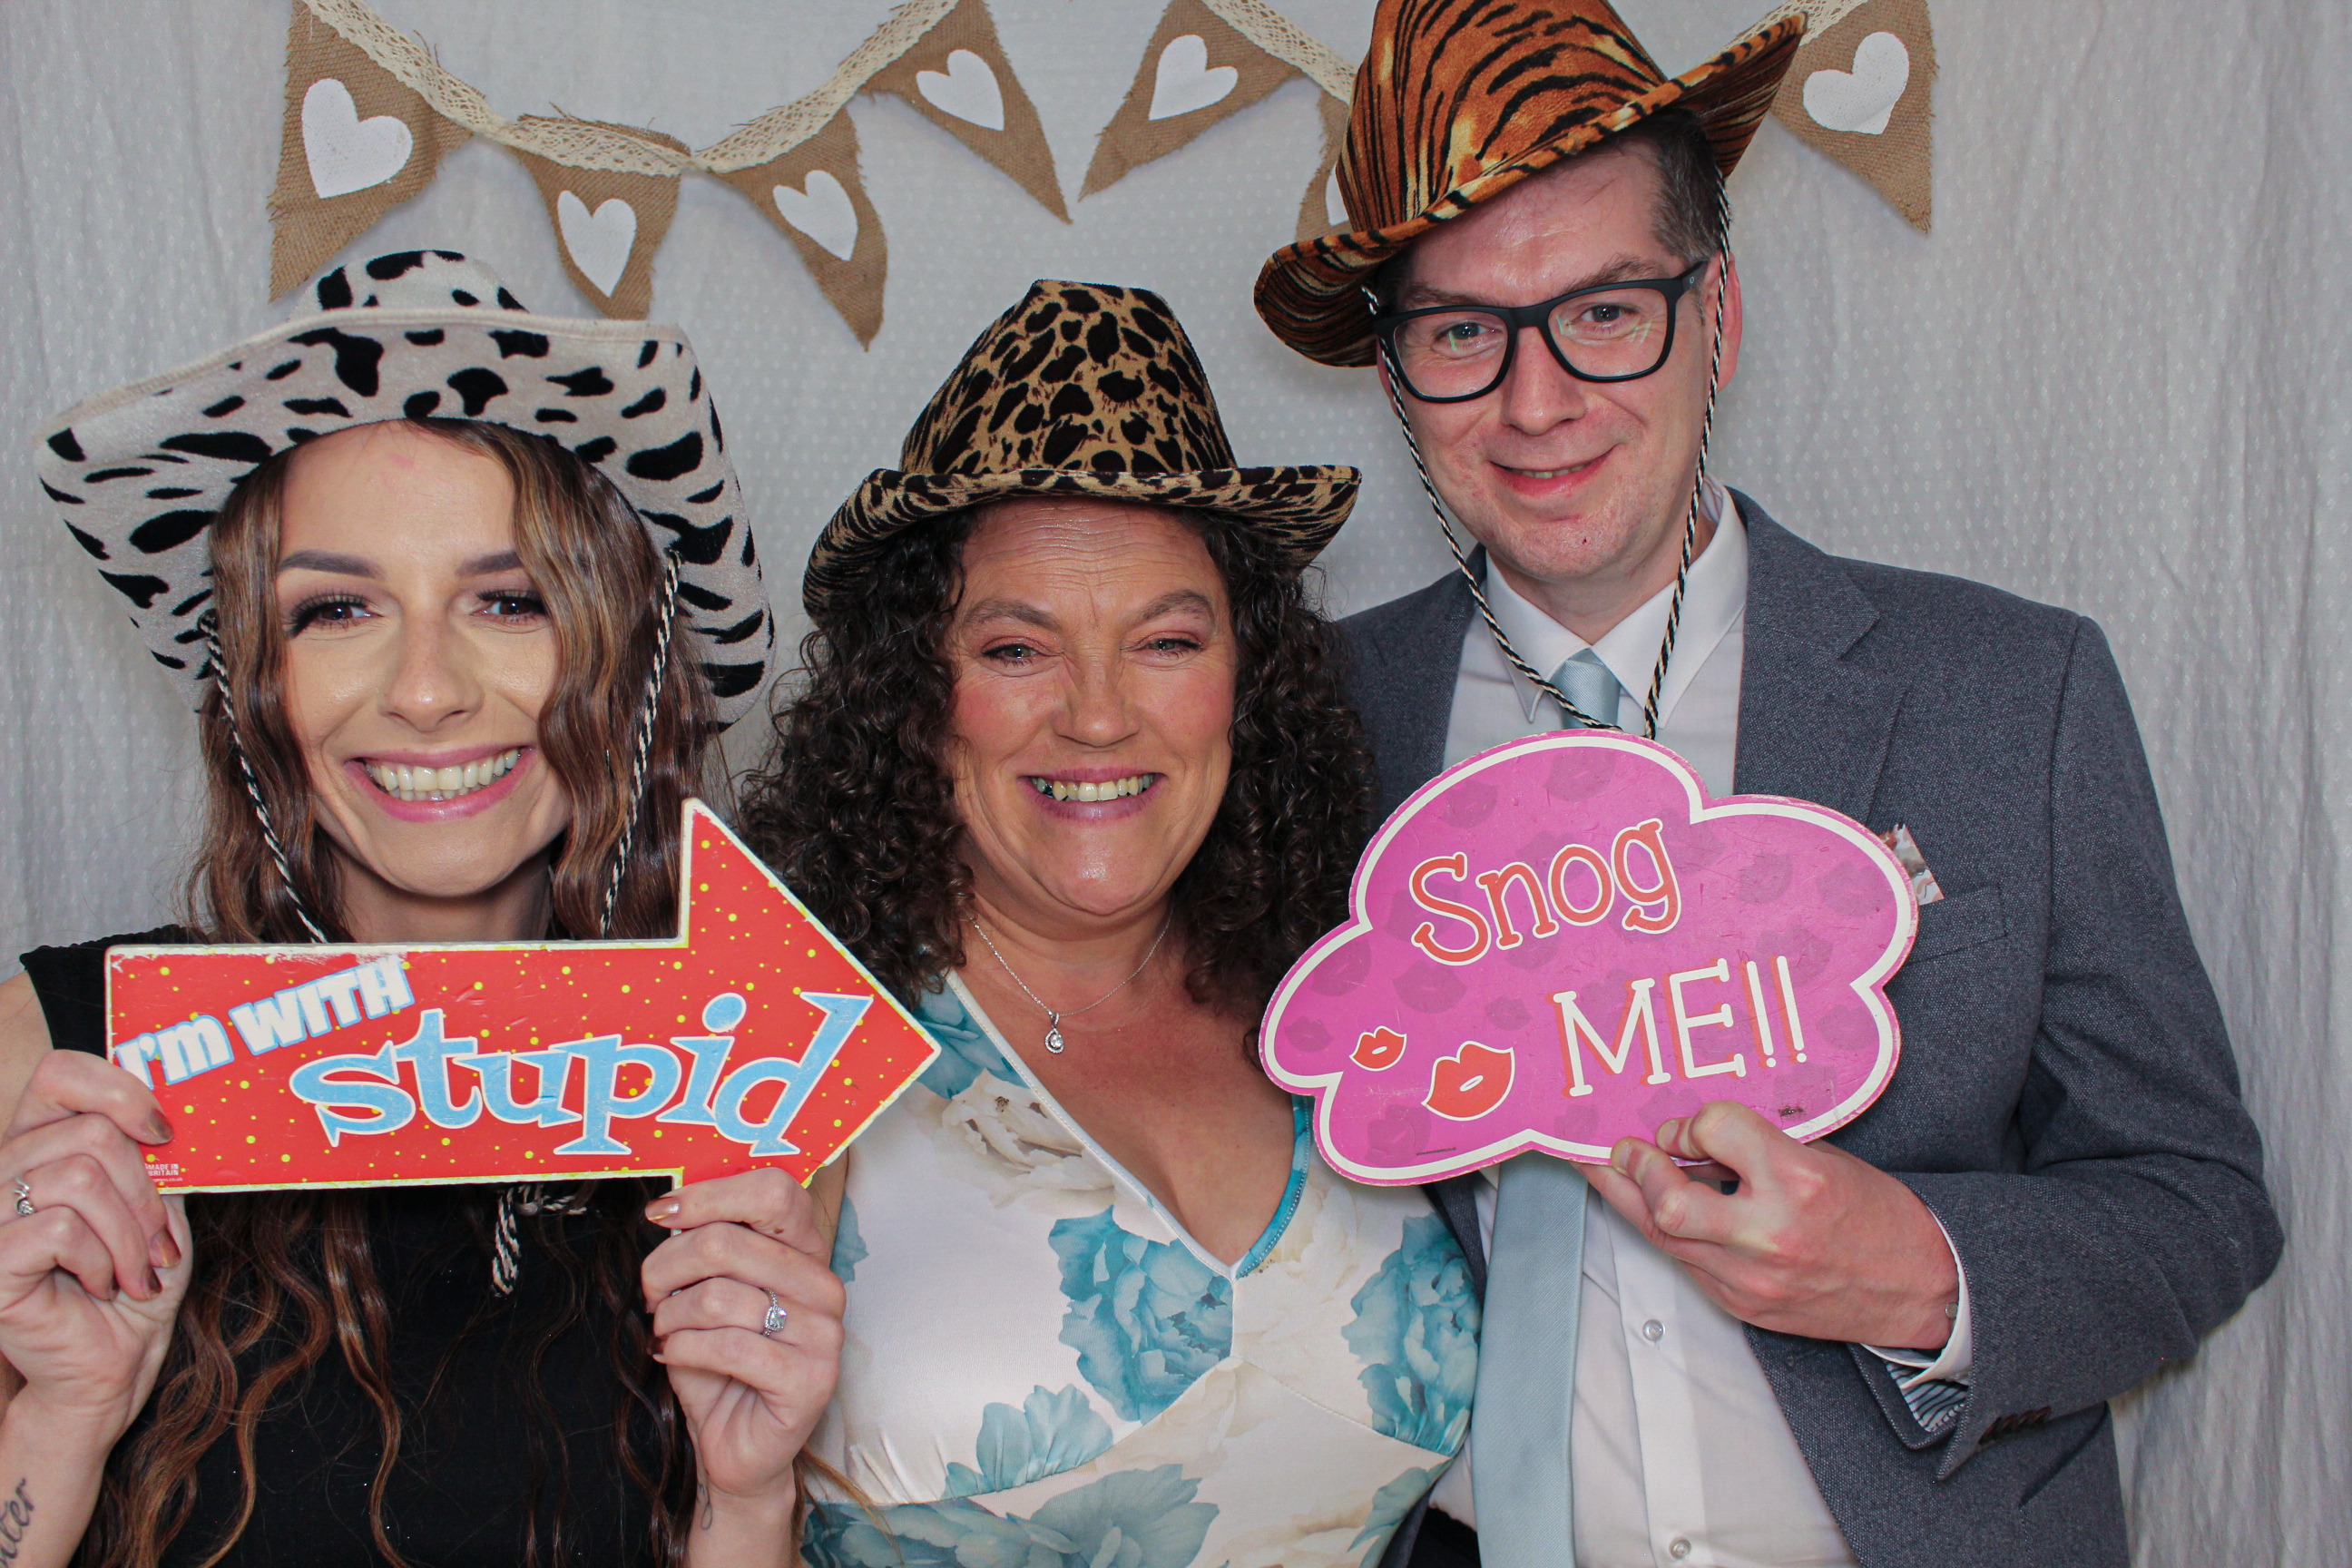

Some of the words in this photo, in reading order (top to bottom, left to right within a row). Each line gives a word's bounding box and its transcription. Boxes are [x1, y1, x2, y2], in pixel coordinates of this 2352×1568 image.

[1408, 818, 1681, 966] Snog
[115, 1014, 234, 1090] I'm
[229, 954, 415, 1055] WITH
[289, 992, 875, 1157] stupid
[1546, 956, 1808, 1098] ME!!
